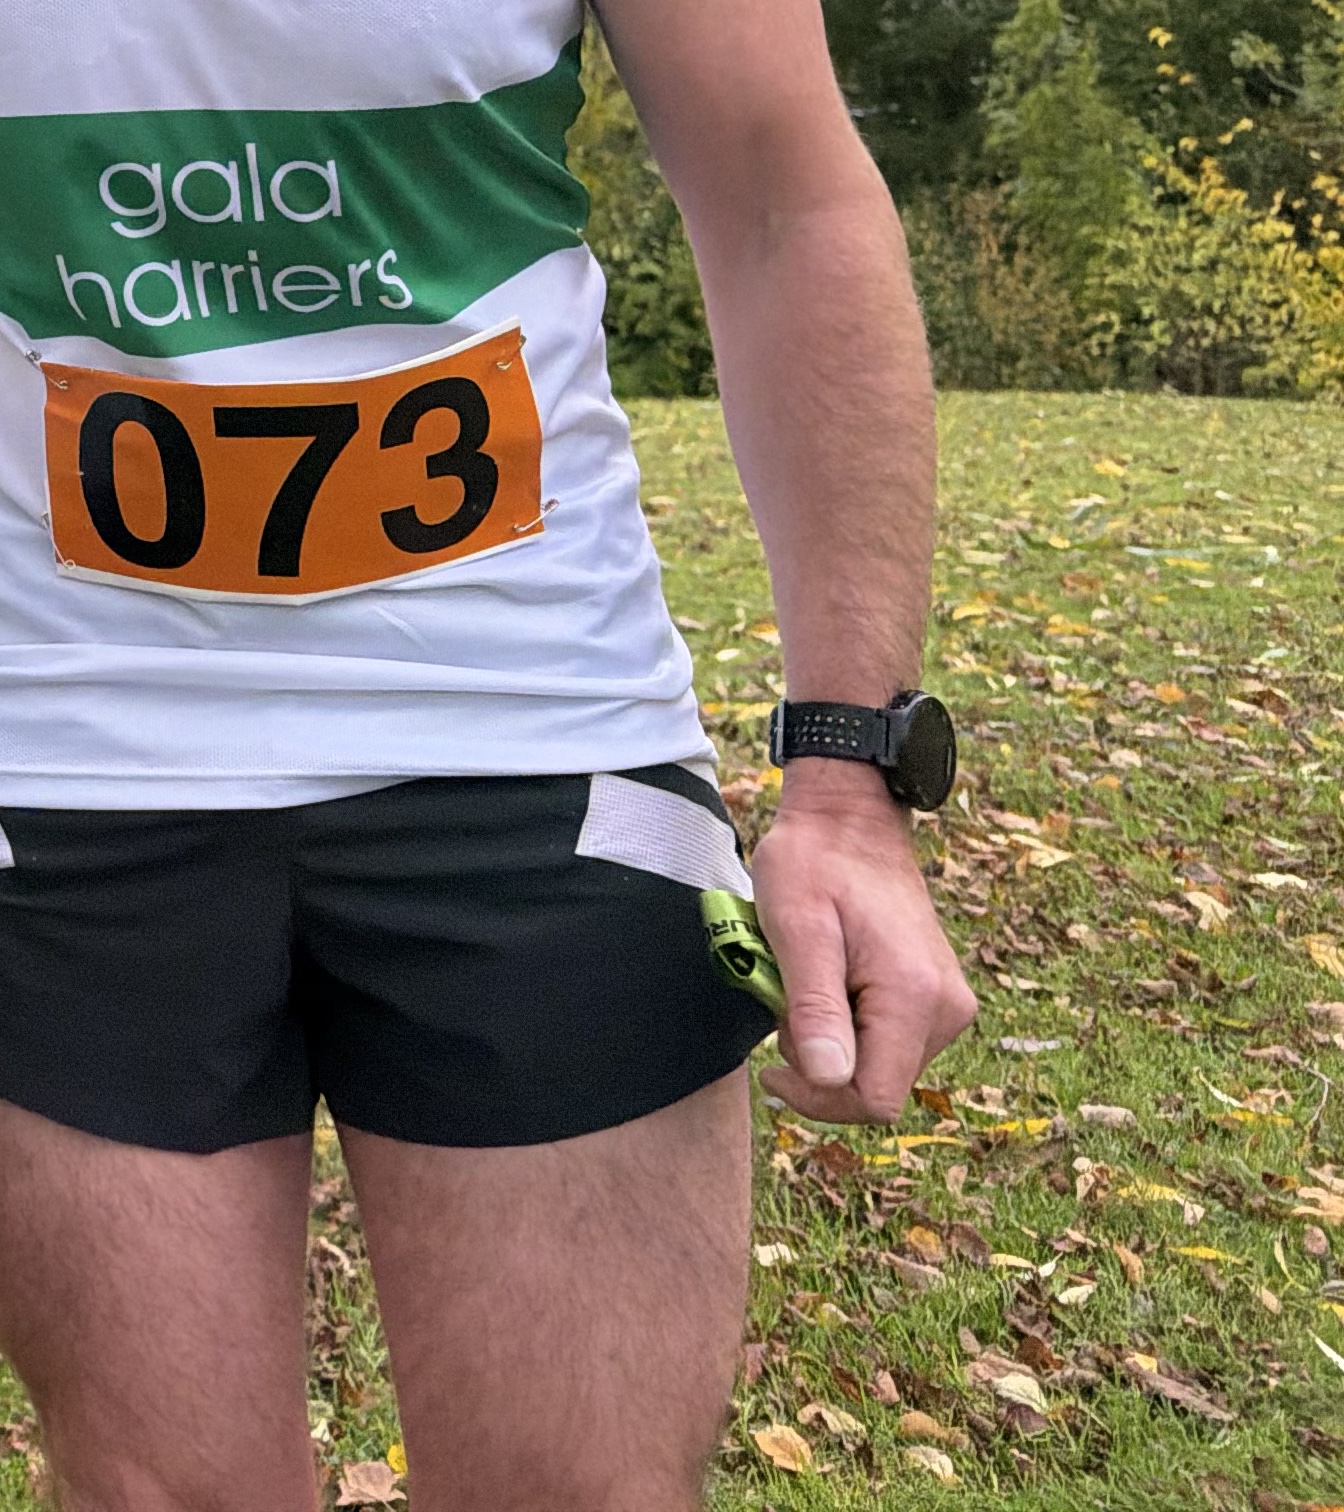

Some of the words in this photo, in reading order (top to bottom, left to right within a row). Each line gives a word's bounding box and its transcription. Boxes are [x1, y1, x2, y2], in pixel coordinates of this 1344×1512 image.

[98, 142, 342, 238] gala
[55, 248, 413, 329] harriers
[77, 376, 499, 578] 073
